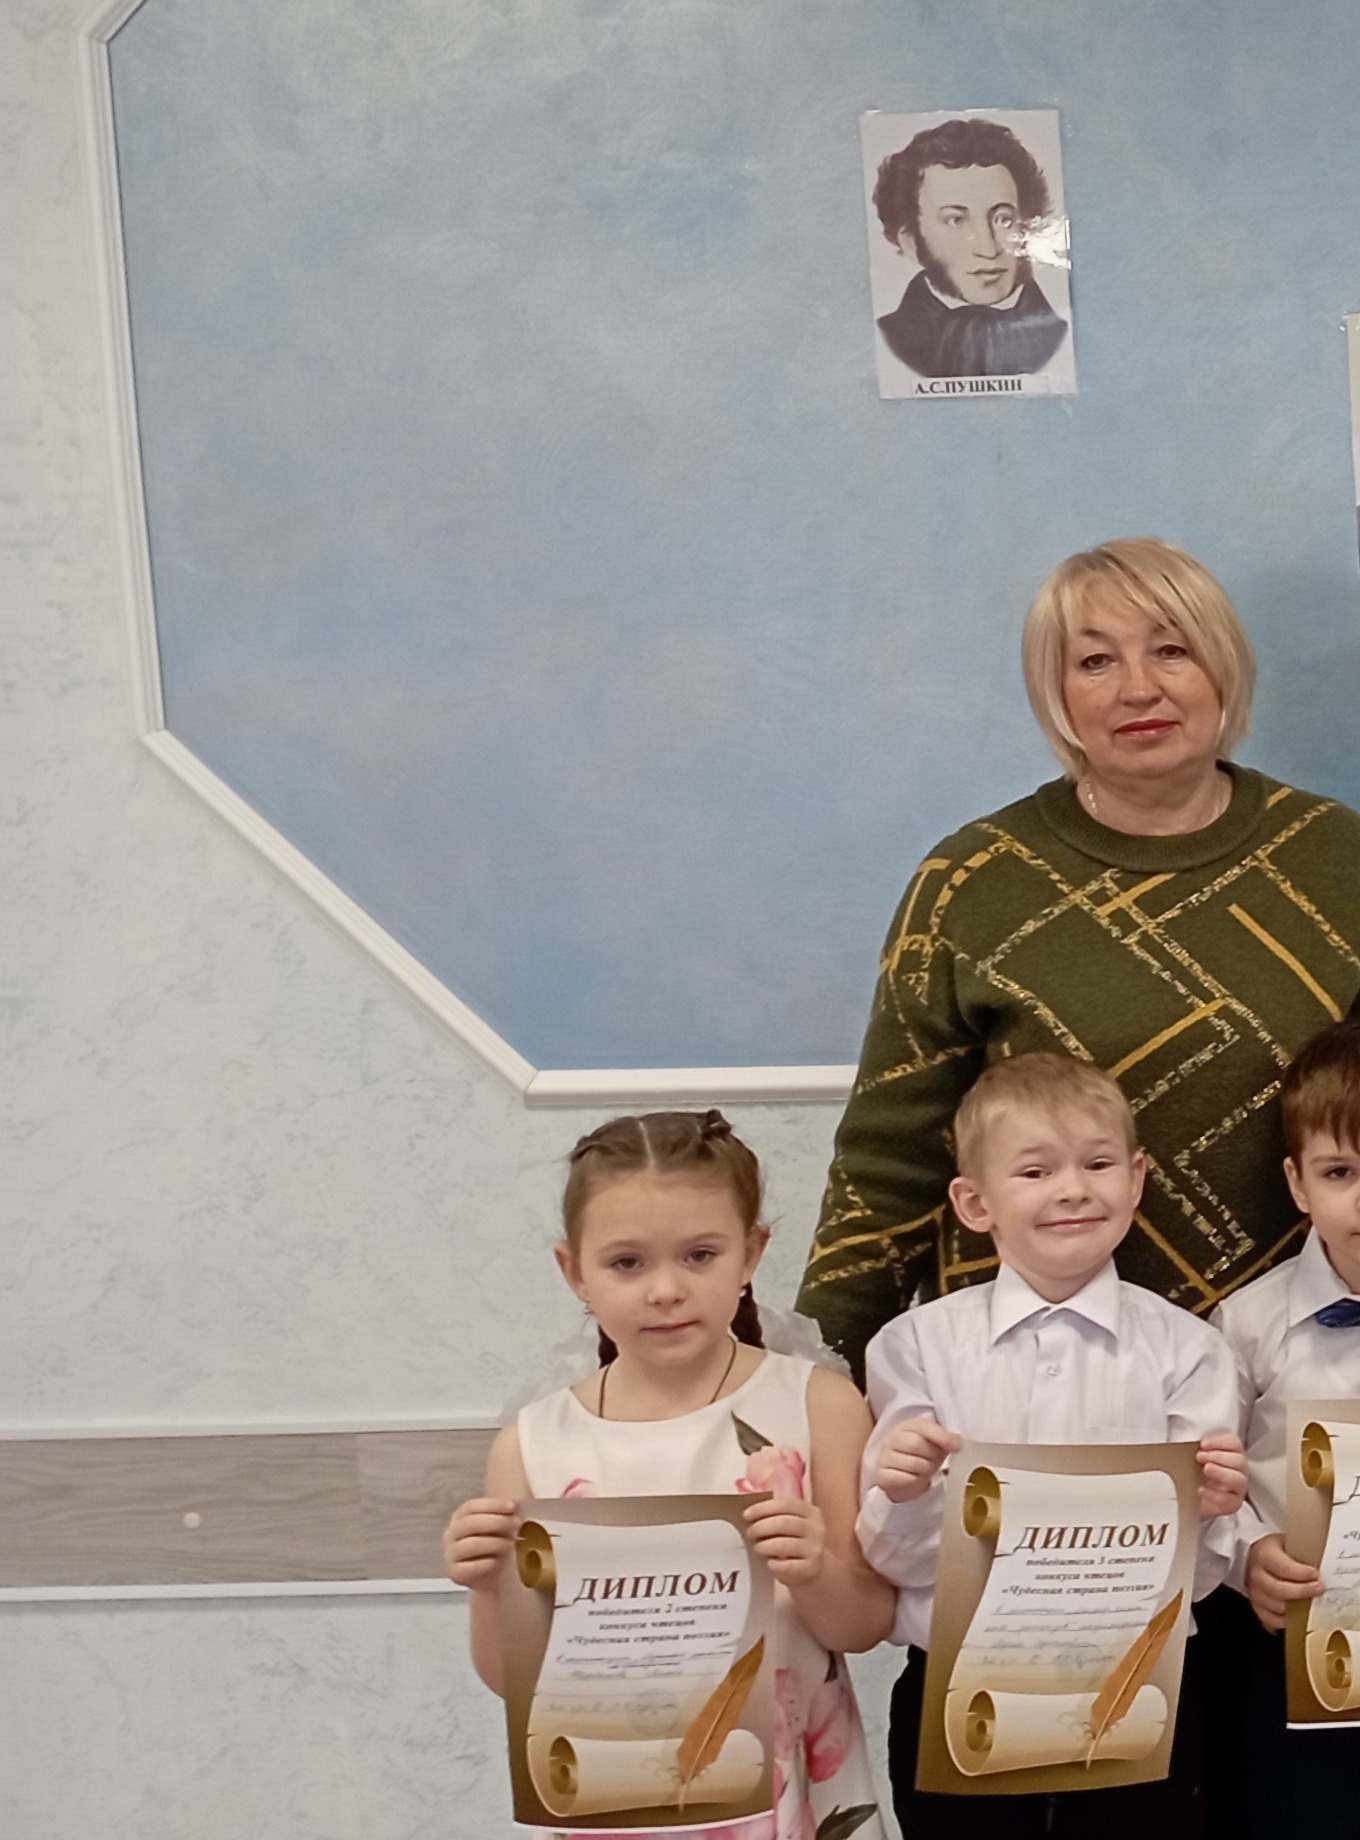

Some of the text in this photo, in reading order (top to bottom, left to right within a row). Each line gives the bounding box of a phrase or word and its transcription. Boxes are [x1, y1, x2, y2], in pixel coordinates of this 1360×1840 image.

[915, 379, 1022, 394] А.С.ПУШКИН
[1013, 1522, 1170, 1553] ДИПЛОМ
[573, 1570, 741, 1604] ДИПЛОМ
